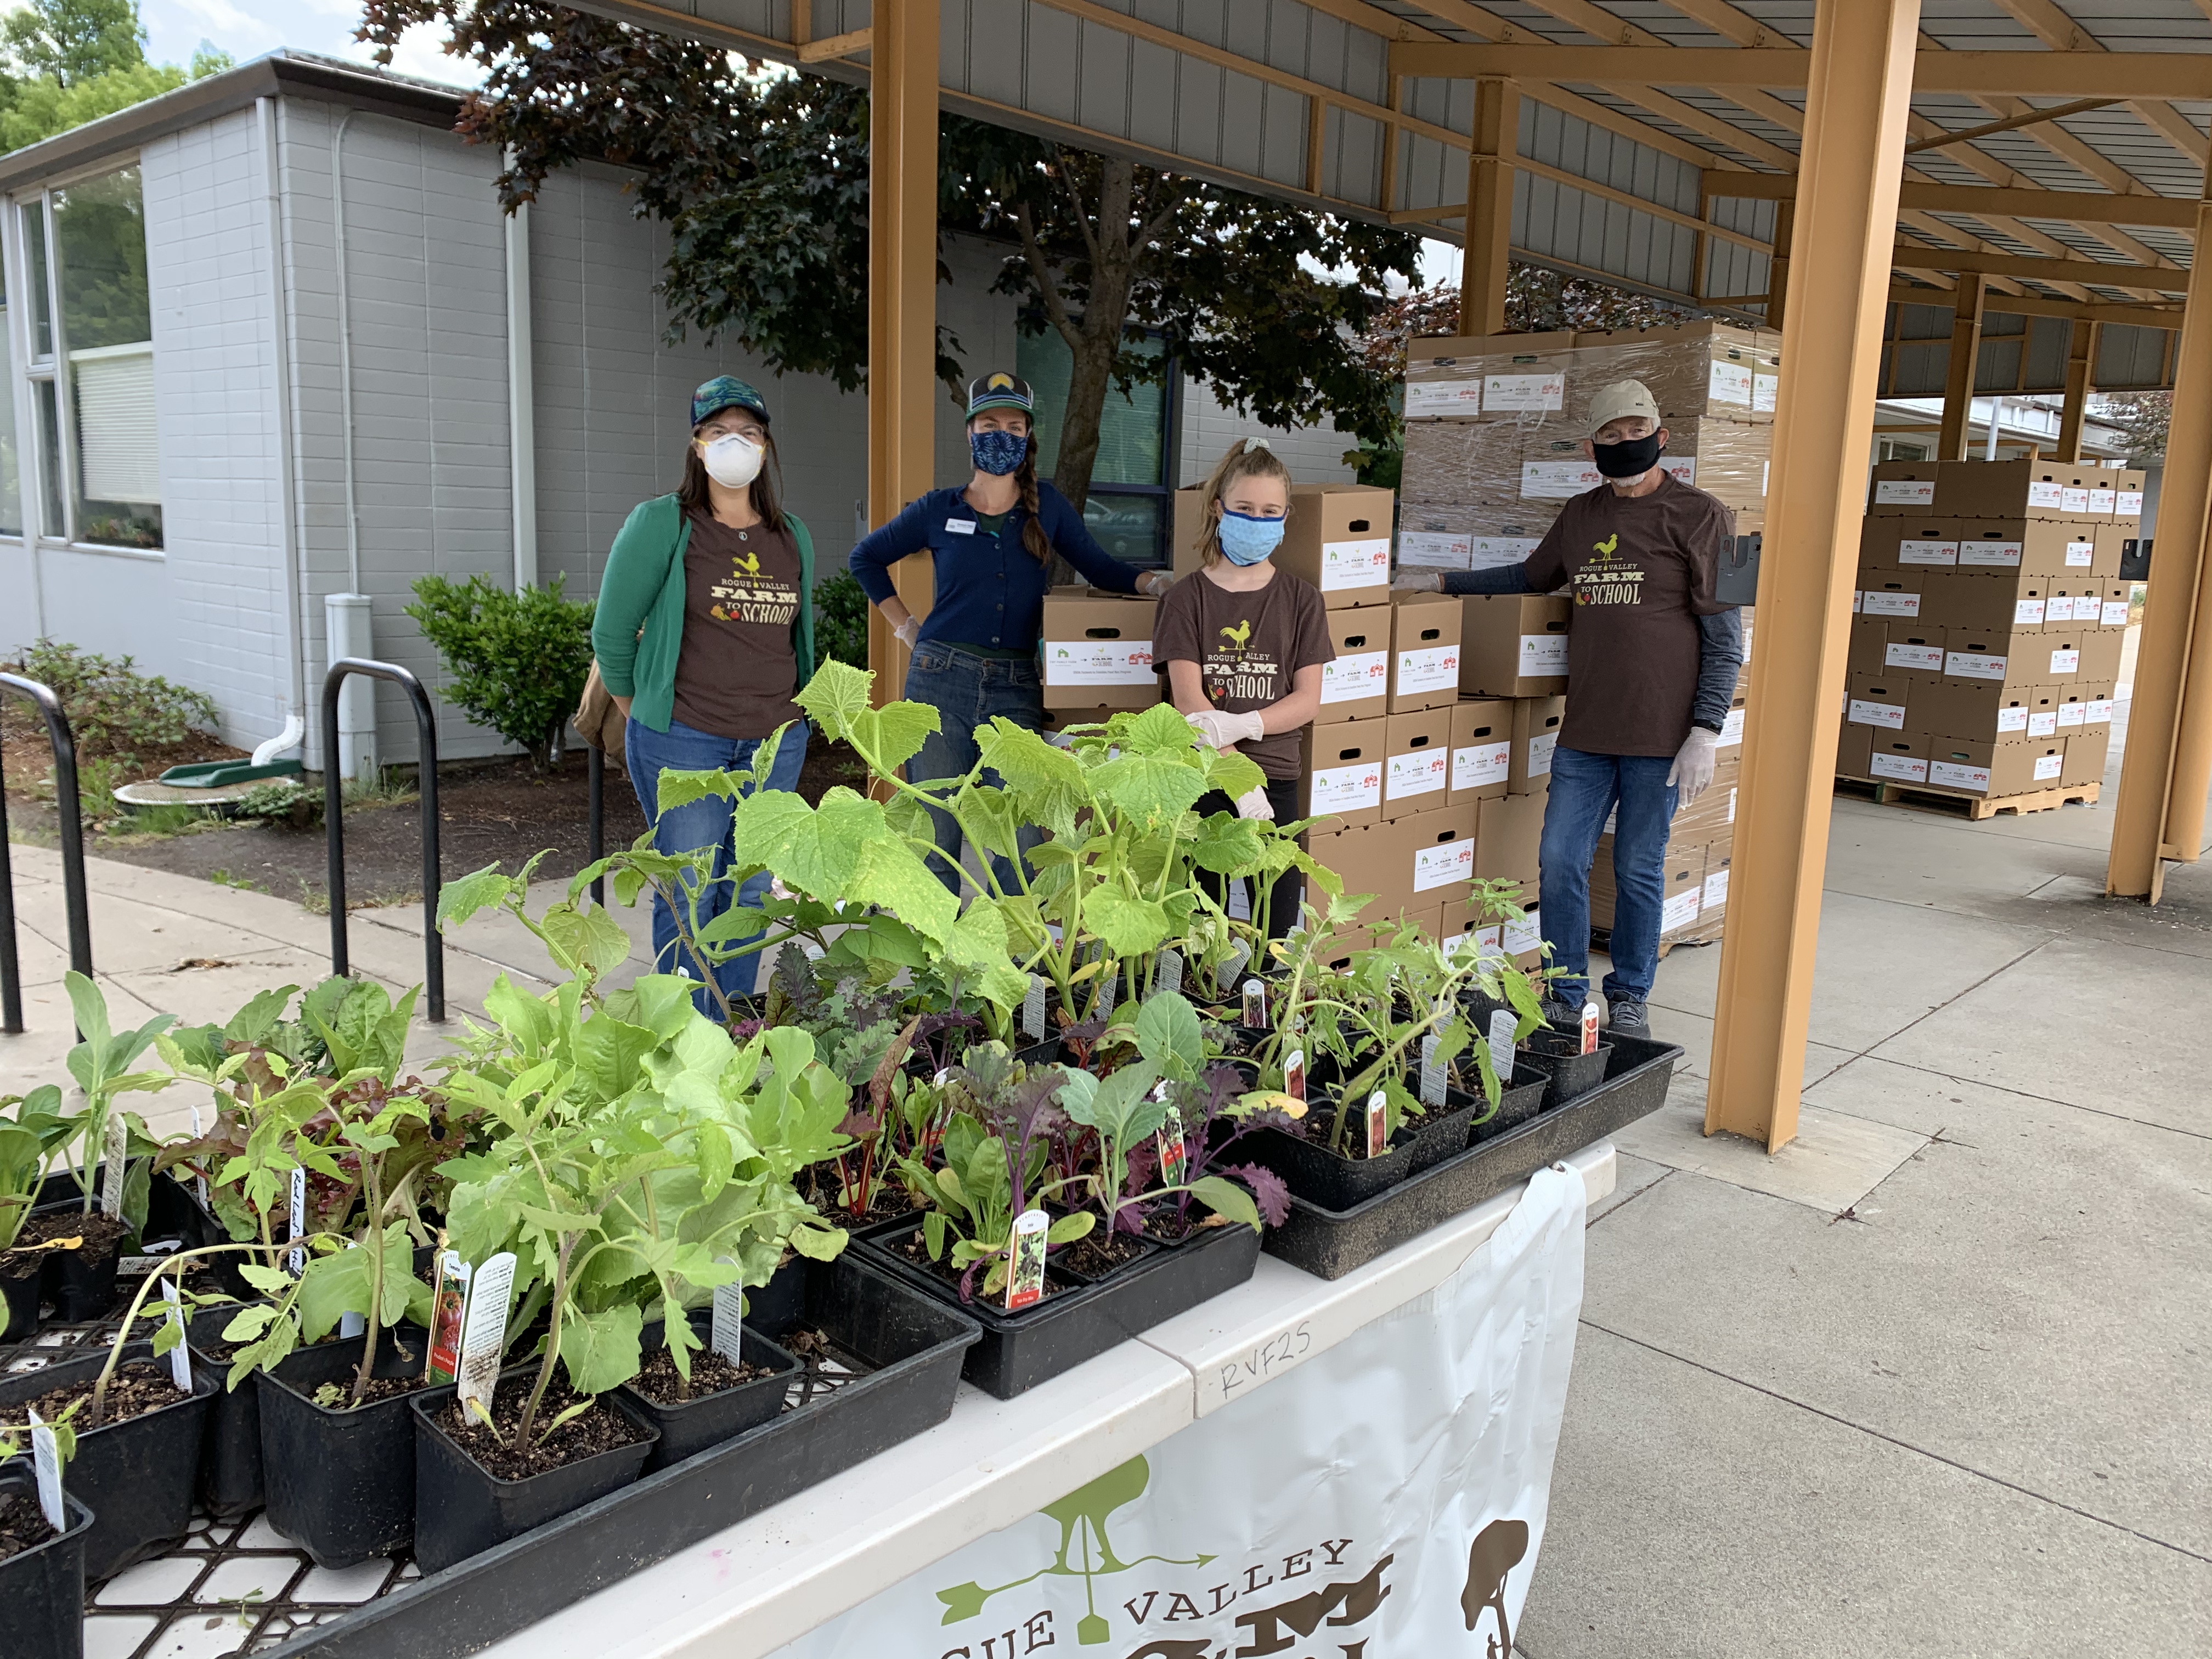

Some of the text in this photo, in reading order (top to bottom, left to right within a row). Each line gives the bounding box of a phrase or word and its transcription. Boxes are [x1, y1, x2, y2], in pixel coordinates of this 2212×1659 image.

[721, 578, 789, 590] ROGUE VALLEY
[1574, 572, 1645, 584] FARM
[711, 586, 798, 603] FARM
[1590, 584, 1641, 605] SCHOOL
[726, 602, 794, 625] TO SCHOOL
[1245, 652, 1270, 661] ALLEY
[1203, 662, 1278, 675] FARM
[1212, 678, 1224, 686] TO
[449, 1263, 460, 1272] Tomato
[1124, 1539, 1353, 1625] VALLEY
